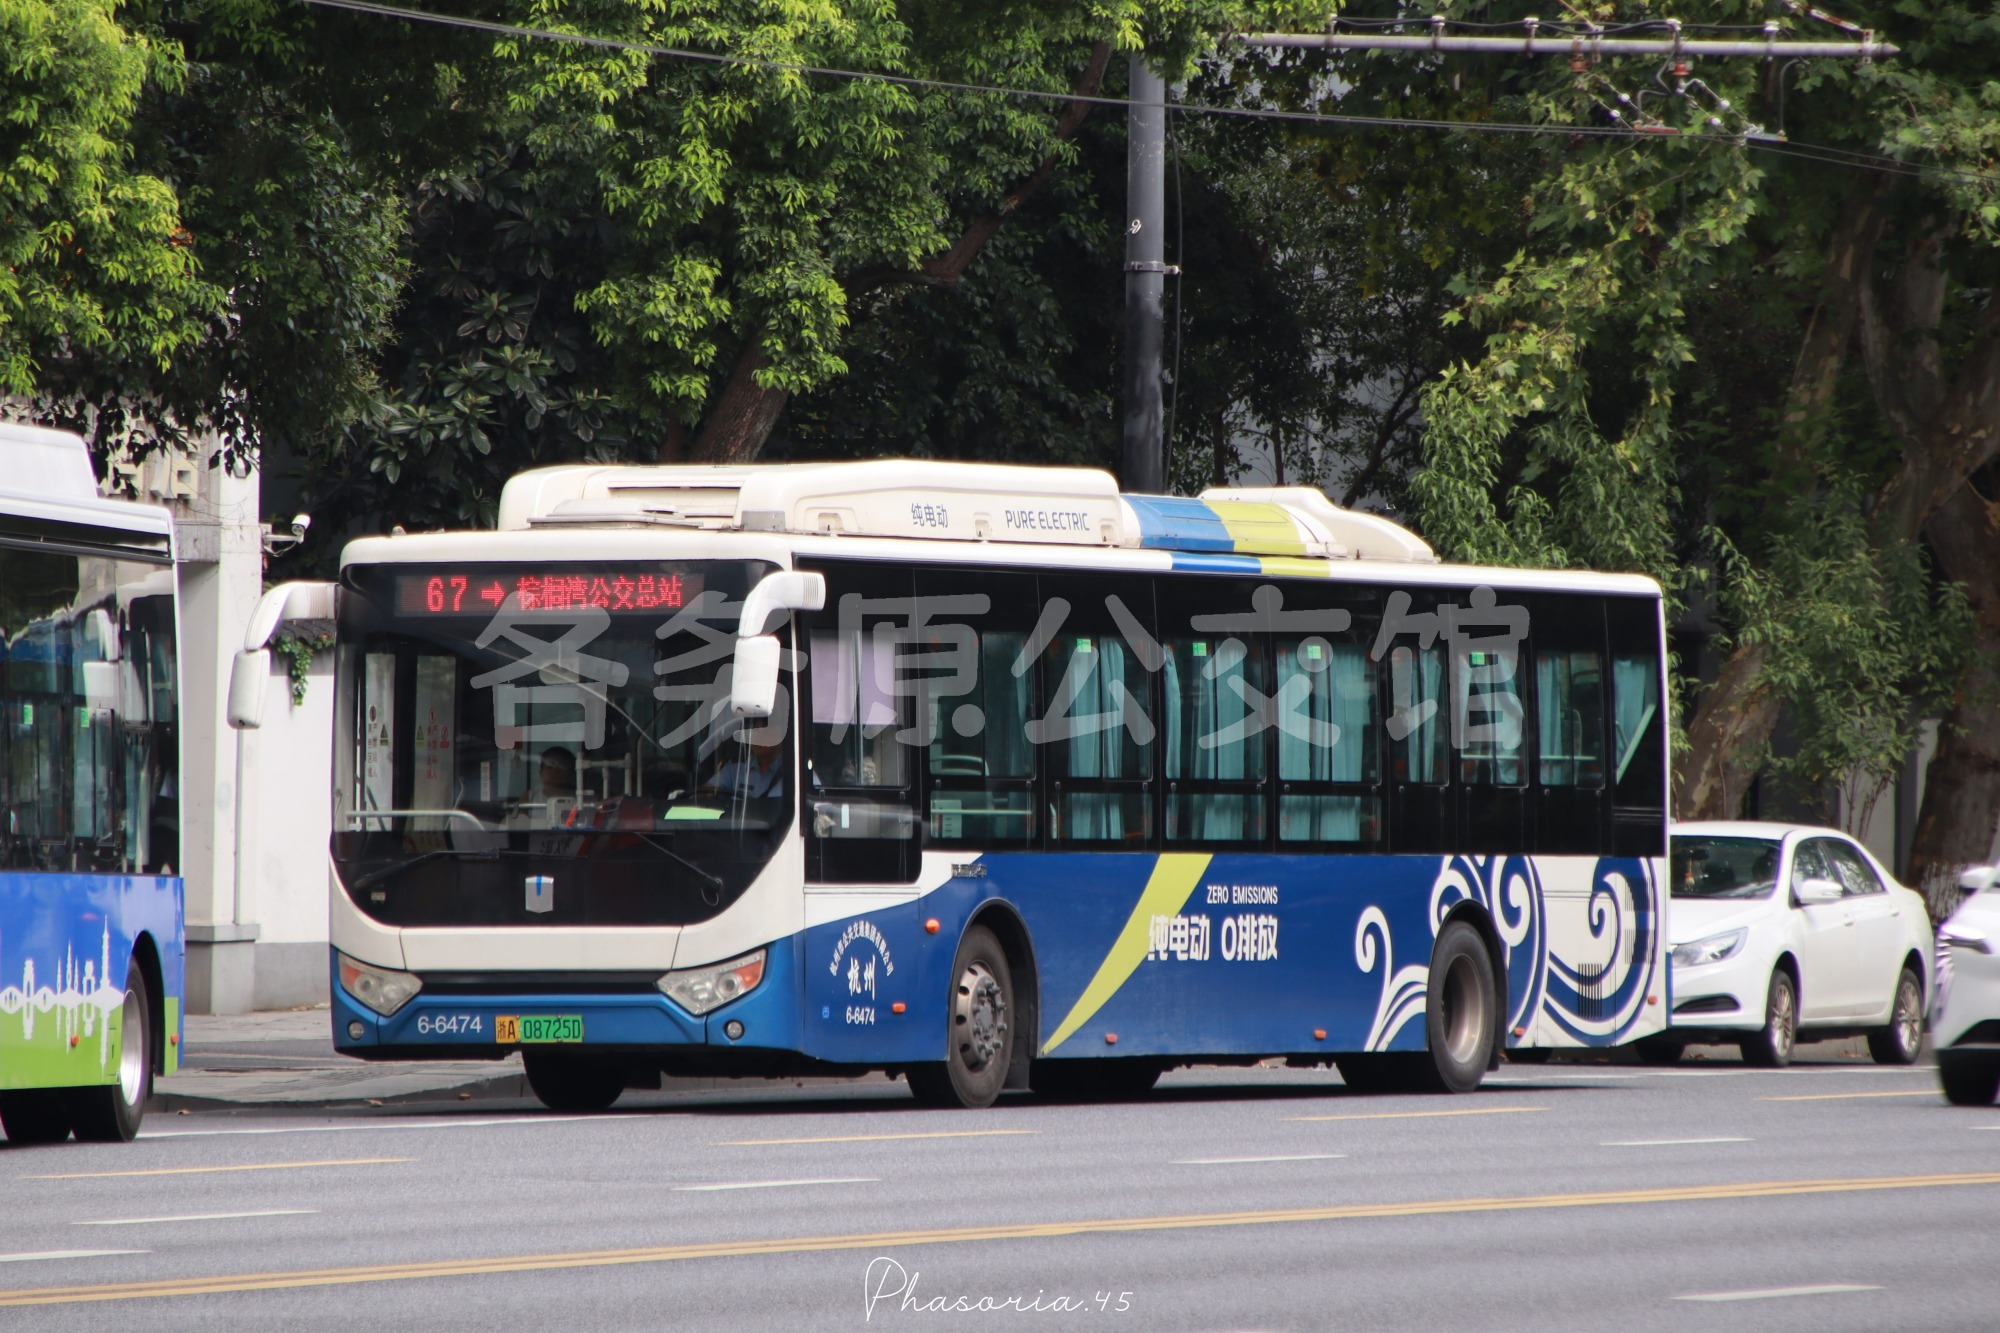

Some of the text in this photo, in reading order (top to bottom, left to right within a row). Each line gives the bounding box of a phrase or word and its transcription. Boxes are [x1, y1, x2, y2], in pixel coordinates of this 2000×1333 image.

[911, 502, 948, 529] 纯电动
[1005, 509, 1090, 532] PURE ELECTRIC
[427, 575, 682, 612] 67 棕榈湾公交总站
[1207, 885, 1278, 905] ZERO EMISSIONS
[1147, 914, 1278, 961] 纯电动 0排放
[847, 954, 876, 1001] 杭州
[417, 1014, 482, 1035] 6-6474
[846, 1006, 875, 1026] 6-6474
